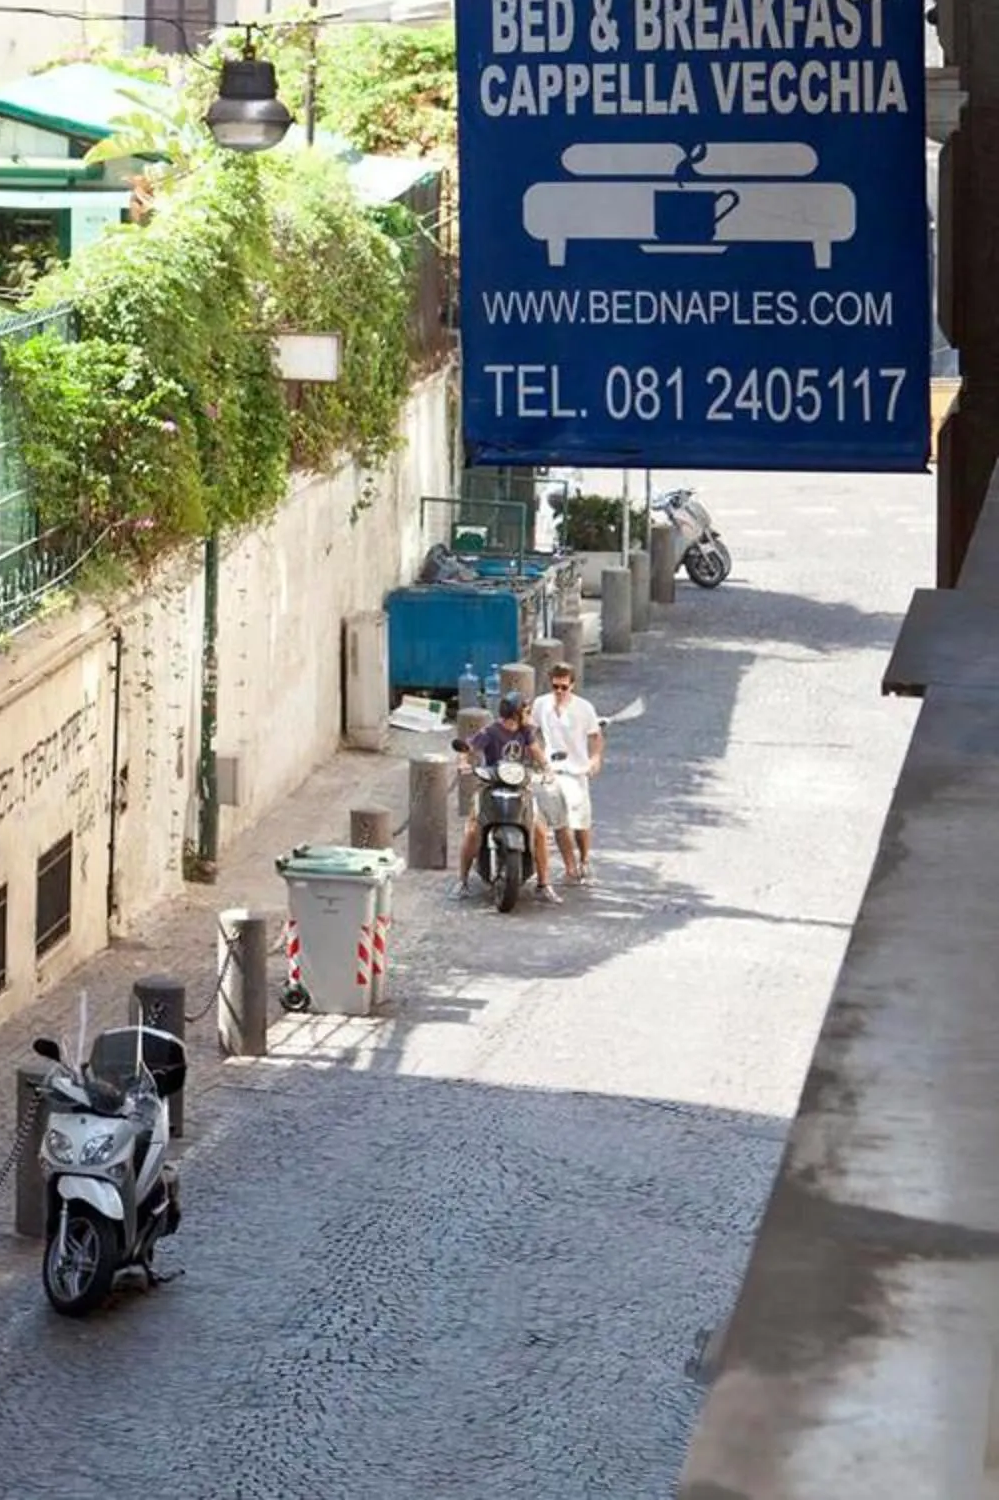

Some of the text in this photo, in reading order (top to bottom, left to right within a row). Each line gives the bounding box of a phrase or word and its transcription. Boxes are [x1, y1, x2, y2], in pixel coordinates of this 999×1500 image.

[480, 59, 908, 117] CAPPELLA VECCHIA
[482, 290, 893, 326] WWW.BEDNAPLES.COM
[483, 364, 907, 422] TEL. 081 2405117
